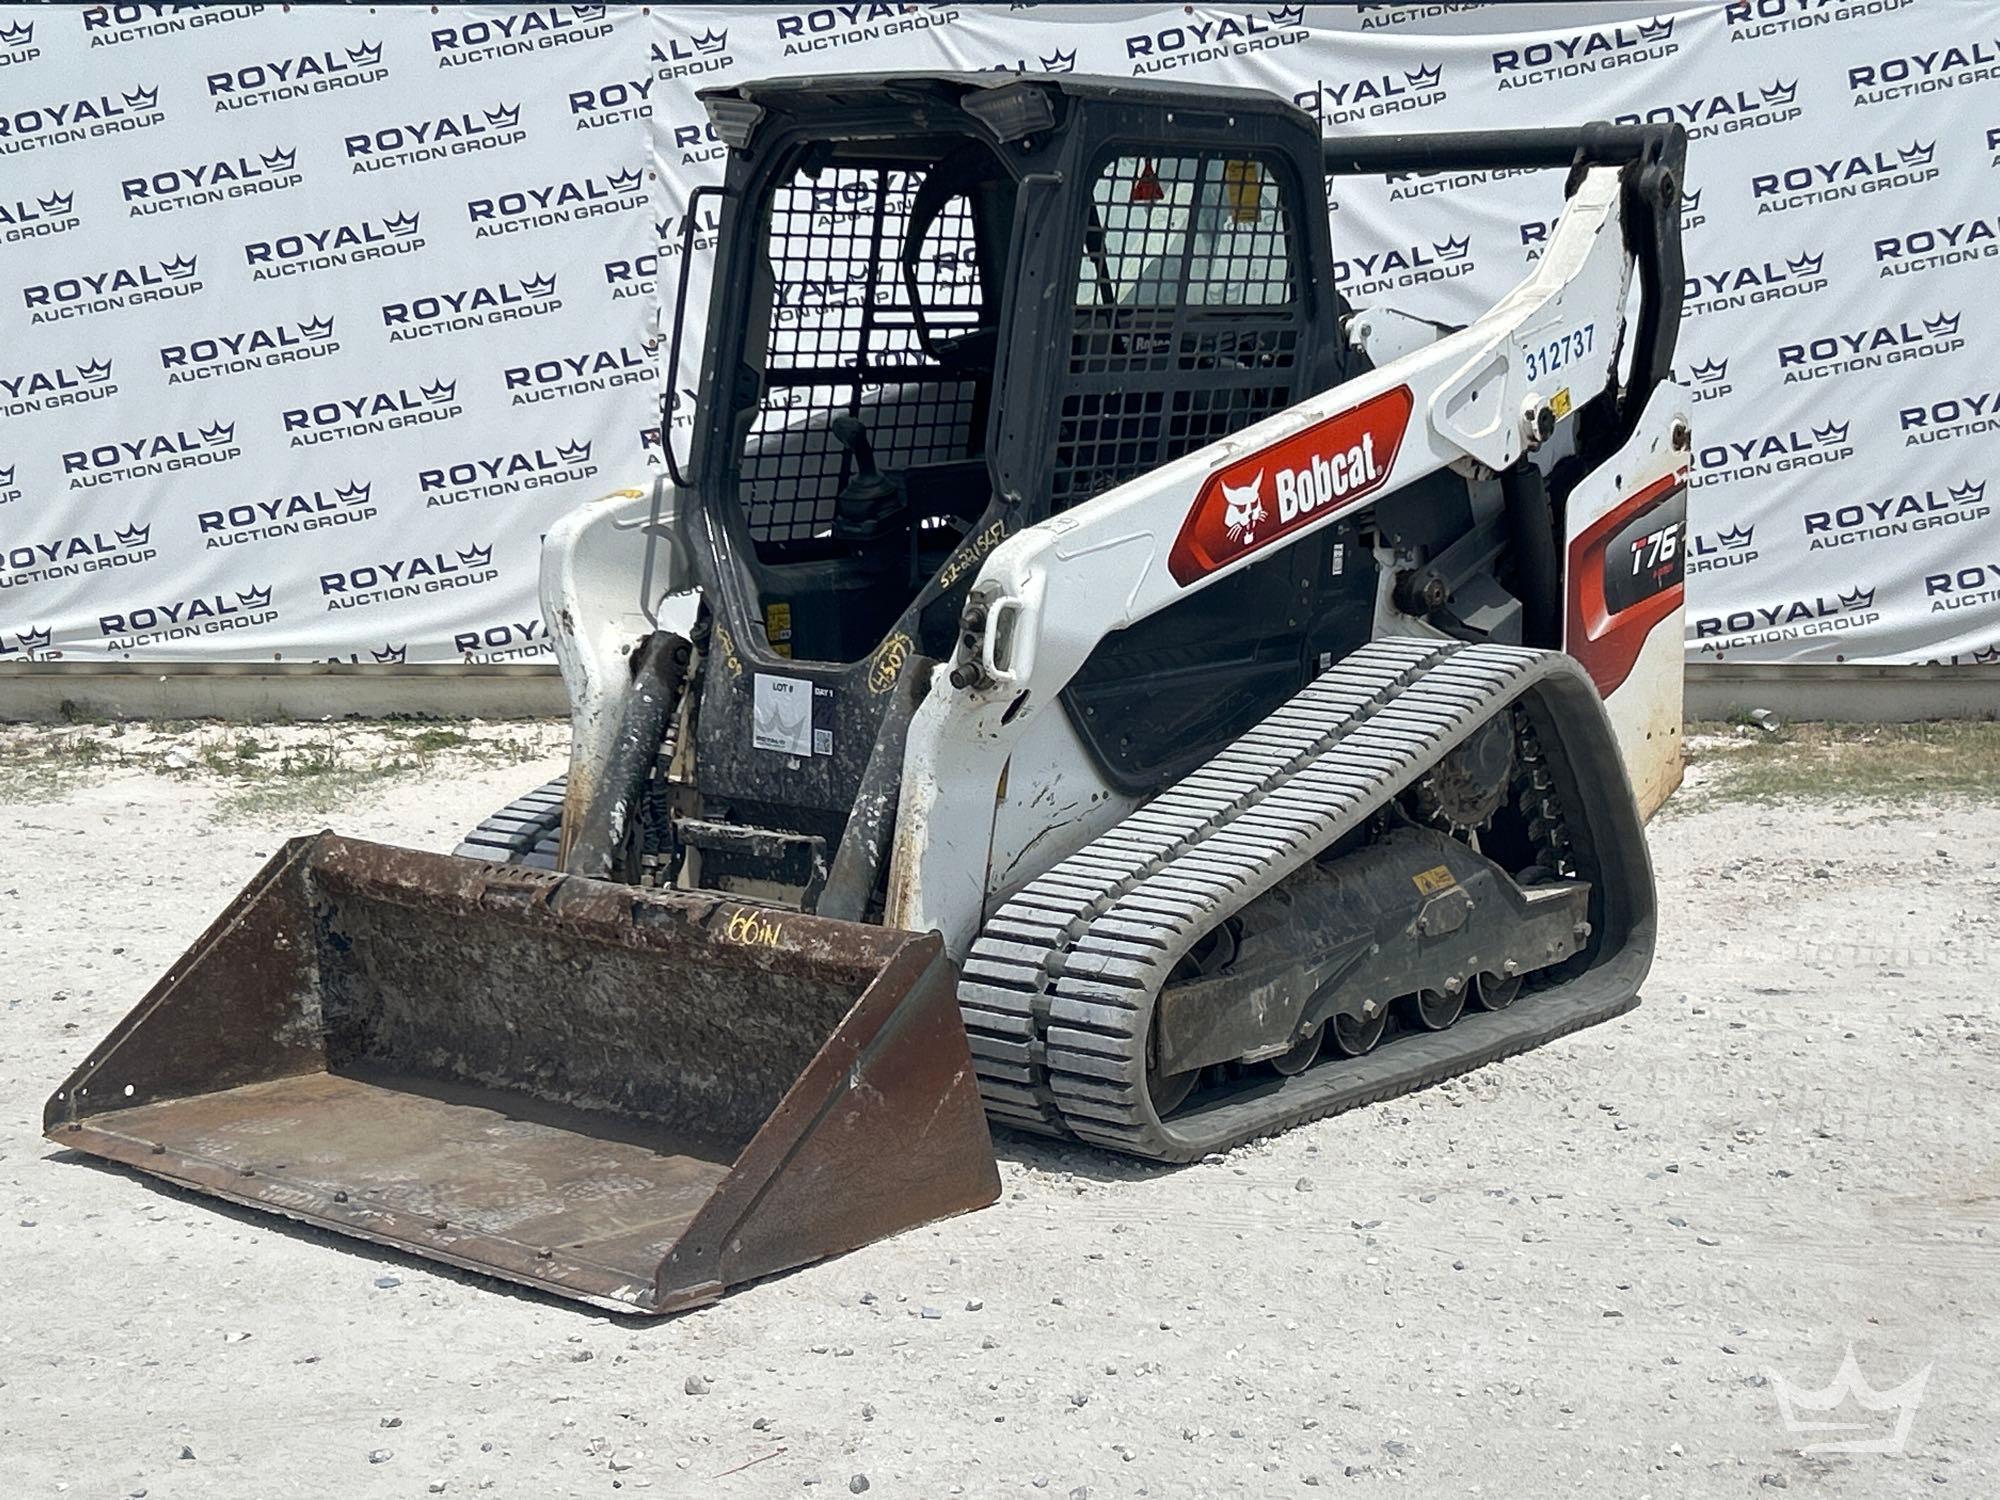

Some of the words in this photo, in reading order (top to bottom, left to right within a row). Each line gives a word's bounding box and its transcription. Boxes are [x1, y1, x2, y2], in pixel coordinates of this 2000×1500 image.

[83, 3, 207, 31] ROY
[91, 18, 185, 49] AUCTION
[190, 5, 265, 28] GROUP
[431, 7, 572, 53] ROYAL
[783, 27, 880, 56] AUCTION
[884, 11, 960, 36] GROUP
[1126, 13, 1268, 59] ROYAL
[1361, 4, 1459, 31] AUCTION
[1731, 11, 1830, 43] AUCTION
[0, 48, 40, 66] OUP
[439, 39, 534, 69] AUCTION
[538, 23, 613, 49] GROUP
[1132, 45, 1228, 76] AUCTION
[1233, 30, 1310, 56] GROUP
[1492, 28, 1637, 73] ROYAL
[1498, 60, 1596, 91] AUCTION
[1601, 43, 1679, 70] GROUP
[1848, 43, 1995, 91] ROYAL
[207, 51, 348, 96] ROYAL
[658, 55, 733, 81] GROUP
[1854, 75, 1953, 108] AUCTION
[1958, 65, 2000, 85] GRO
[215, 83, 309, 114] AUCTION
[314, 68, 389, 93] GROUP
[569, 77, 653, 114] ROY
[1293, 75, 1405, 112] OYAL
[1370, 92, 1447, 117] GROUP
[90, 112, 165, 137] GROUP
[345, 113, 486, 158] ROYAL
[576, 105, 653, 131] AUCTIO
[1723, 107, 1803, 134] GROUP
[353, 145, 447, 175] AUCTION
[451, 130, 526, 155] GROUP
[122, 157, 262, 202] ROYAL
[130, 189, 224, 218] AUCTION
[228, 173, 302, 199] GROUP
[1390, 172, 1487, 201] AUCTION
[1752, 152, 1898, 199] ROYAL
[1758, 184, 1856, 216] AUCTION
[1861, 167, 1939, 194] GROUP
[468, 178, 608, 223] ROYAL
[476, 210, 570, 239] AUCTION
[574, 194, 649, 220] GROUP
[6, 217, 80, 242] GROUP
[245, 222, 385, 265] ROYAL
[1874, 216, 2000, 262] ROYA
[253, 253, 347, 282] AUCTION
[351, 238, 425, 263] GROUP
[1333, 246, 1433, 282] OYAL
[1338, 277, 1394, 298] TION
[1398, 262, 1475, 288] GROUP
[1684, 263, 1786, 299] OYAL
[1880, 247, 1978, 279] AUCTION
[23, 265, 163, 309] ROYAL
[32, 295, 124, 326] AUCTION
[129, 281, 203, 306] GROUP
[382, 283, 522, 327] ROYAL
[1680, 294, 1746, 318] CTION
[1751, 278, 1828, 304] GROUP
[390, 314, 484, 343] AUCTION
[488, 299, 562, 324] GROUP
[160, 326, 300, 369] ROYAL
[169, 356, 262, 385] AUCTION
[266, 341, 340, 366] GROUP
[1526, 323, 1594, 381] 312737
[1778, 322, 1924, 369] ROYAL
[1784, 354, 1882, 385] AUCTION
[1887, 338, 1964, 364] GROUP
[0, 368, 78, 399] YAL
[504, 347, 643, 390] ROYAL
[512, 377, 605, 407] AUCTION
[609, 368, 659, 387] GRO
[45, 384, 118, 409] GROUP
[282, 389, 422, 432] ROYAL
[1900, 392, 2000, 431] ROY
[291, 419, 384, 449] AUCTION
[388, 405, 462, 430] GROUP
[62, 431, 201, 474] ROYAL
[70, 461, 163, 491] AUCTION
[167, 447, 241, 472] GROUP
[419, 449, 558, 492] ROYAL
[1689, 463, 1771, 488] UCTION
[1776, 447, 1854, 472] GROUP
[427, 479, 520, 509] AUCTION
[524, 465, 598, 490] GROUP
[1275, 432, 1377, 524] Bobcat
[198, 491, 337, 534] ROYAL
[206, 521, 299, 550] AUCTION
[303, 507, 377, 531] GROUP
[1804, 490, 1949, 535] ROYAL
[1810, 521, 1907, 552] AUCTION
[1912, 506, 1990, 531] GROUP
[0, 532, 116, 572] OYAL
[0, 562, 79, 589] UCTION
[83, 548, 156, 573] GROUP
[1631, 523, 1679, 576] T76
[320, 553, 458, 596] ROYAL
[327, 583, 420, 612] AUCTION
[425, 569, 498, 593] GROUP
[99, 595, 238, 635] ROYAL
[1695, 597, 1838, 638] ROYAL
[1931, 590, 2000, 612] AUCTI
[107, 625, 200, 651] AUCTION
[204, 611, 279, 634] GROUP
[455, 620, 549, 653] ROY
[1700, 626, 1797, 653] AUCTION
[1803, 612, 1880, 636] GROUP
[773, 683, 788, 692] LOT
